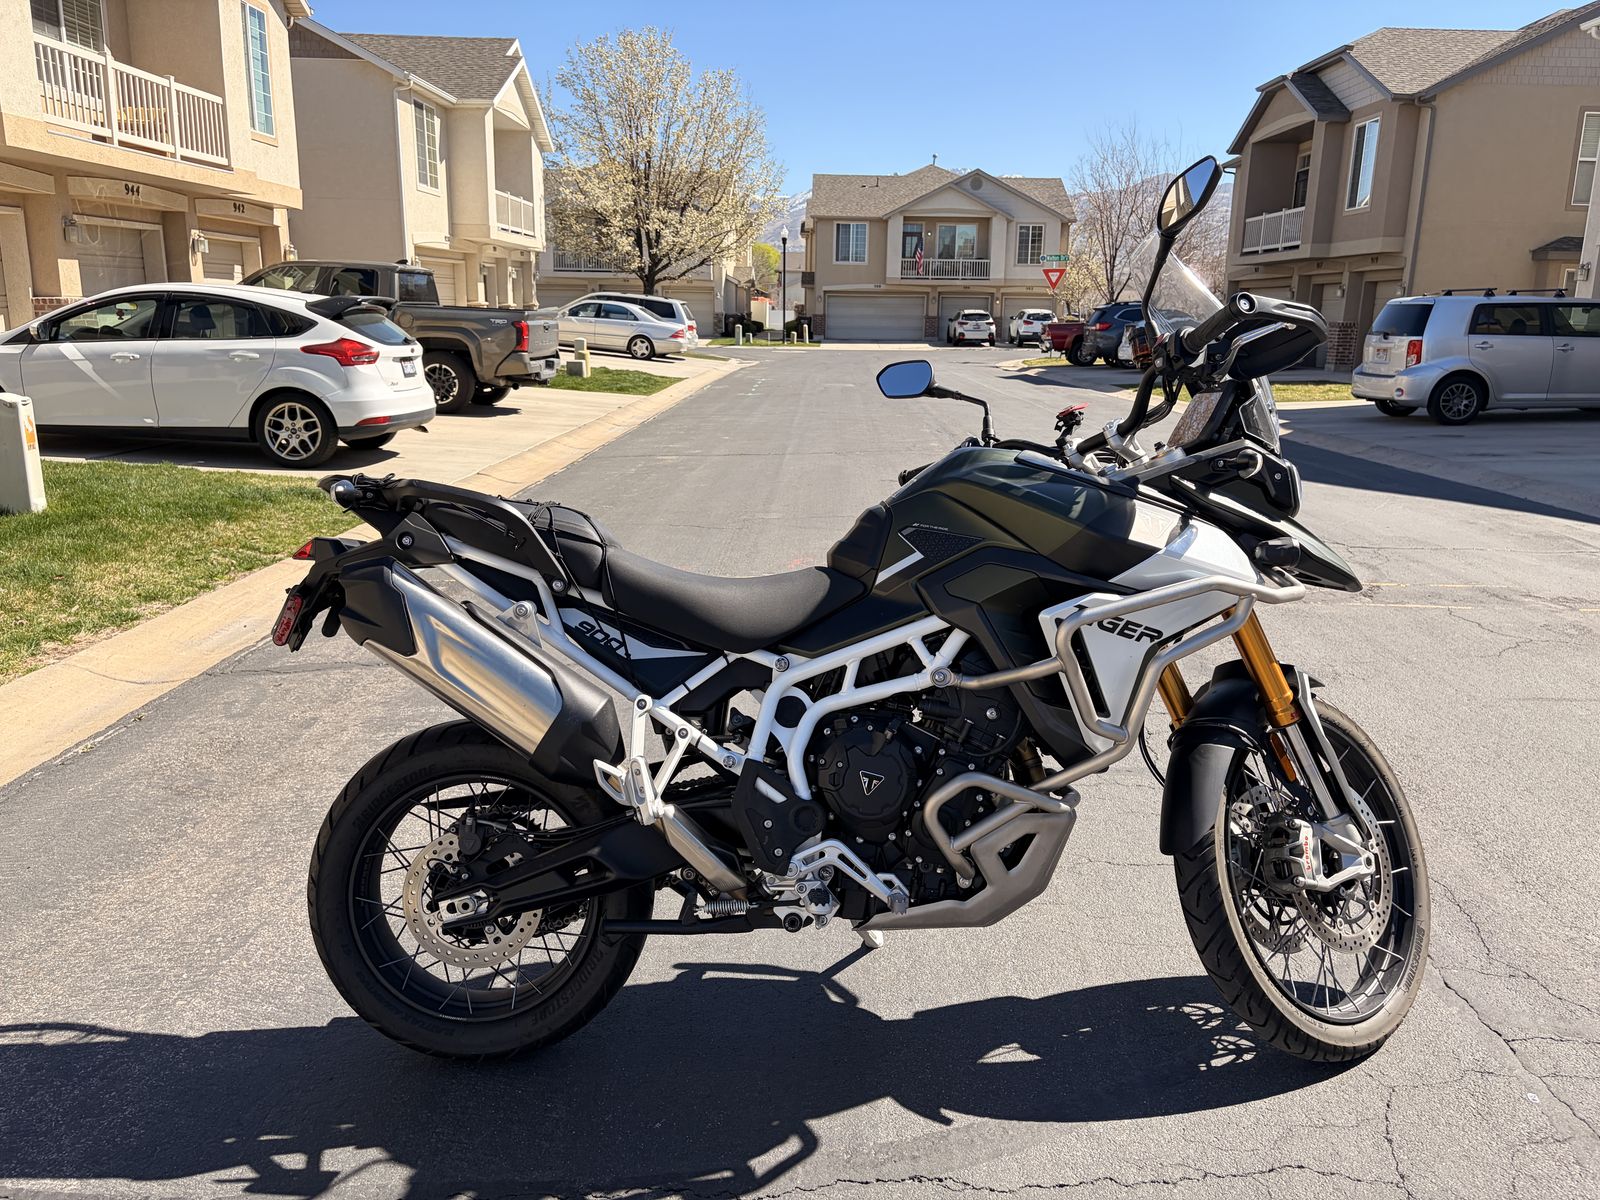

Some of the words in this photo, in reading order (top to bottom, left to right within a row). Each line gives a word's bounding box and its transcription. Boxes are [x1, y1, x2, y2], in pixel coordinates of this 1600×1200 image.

[124, 183, 140, 197] 944
[232, 202, 245, 214] 942
[1303, 835, 1312, 871] brembo
